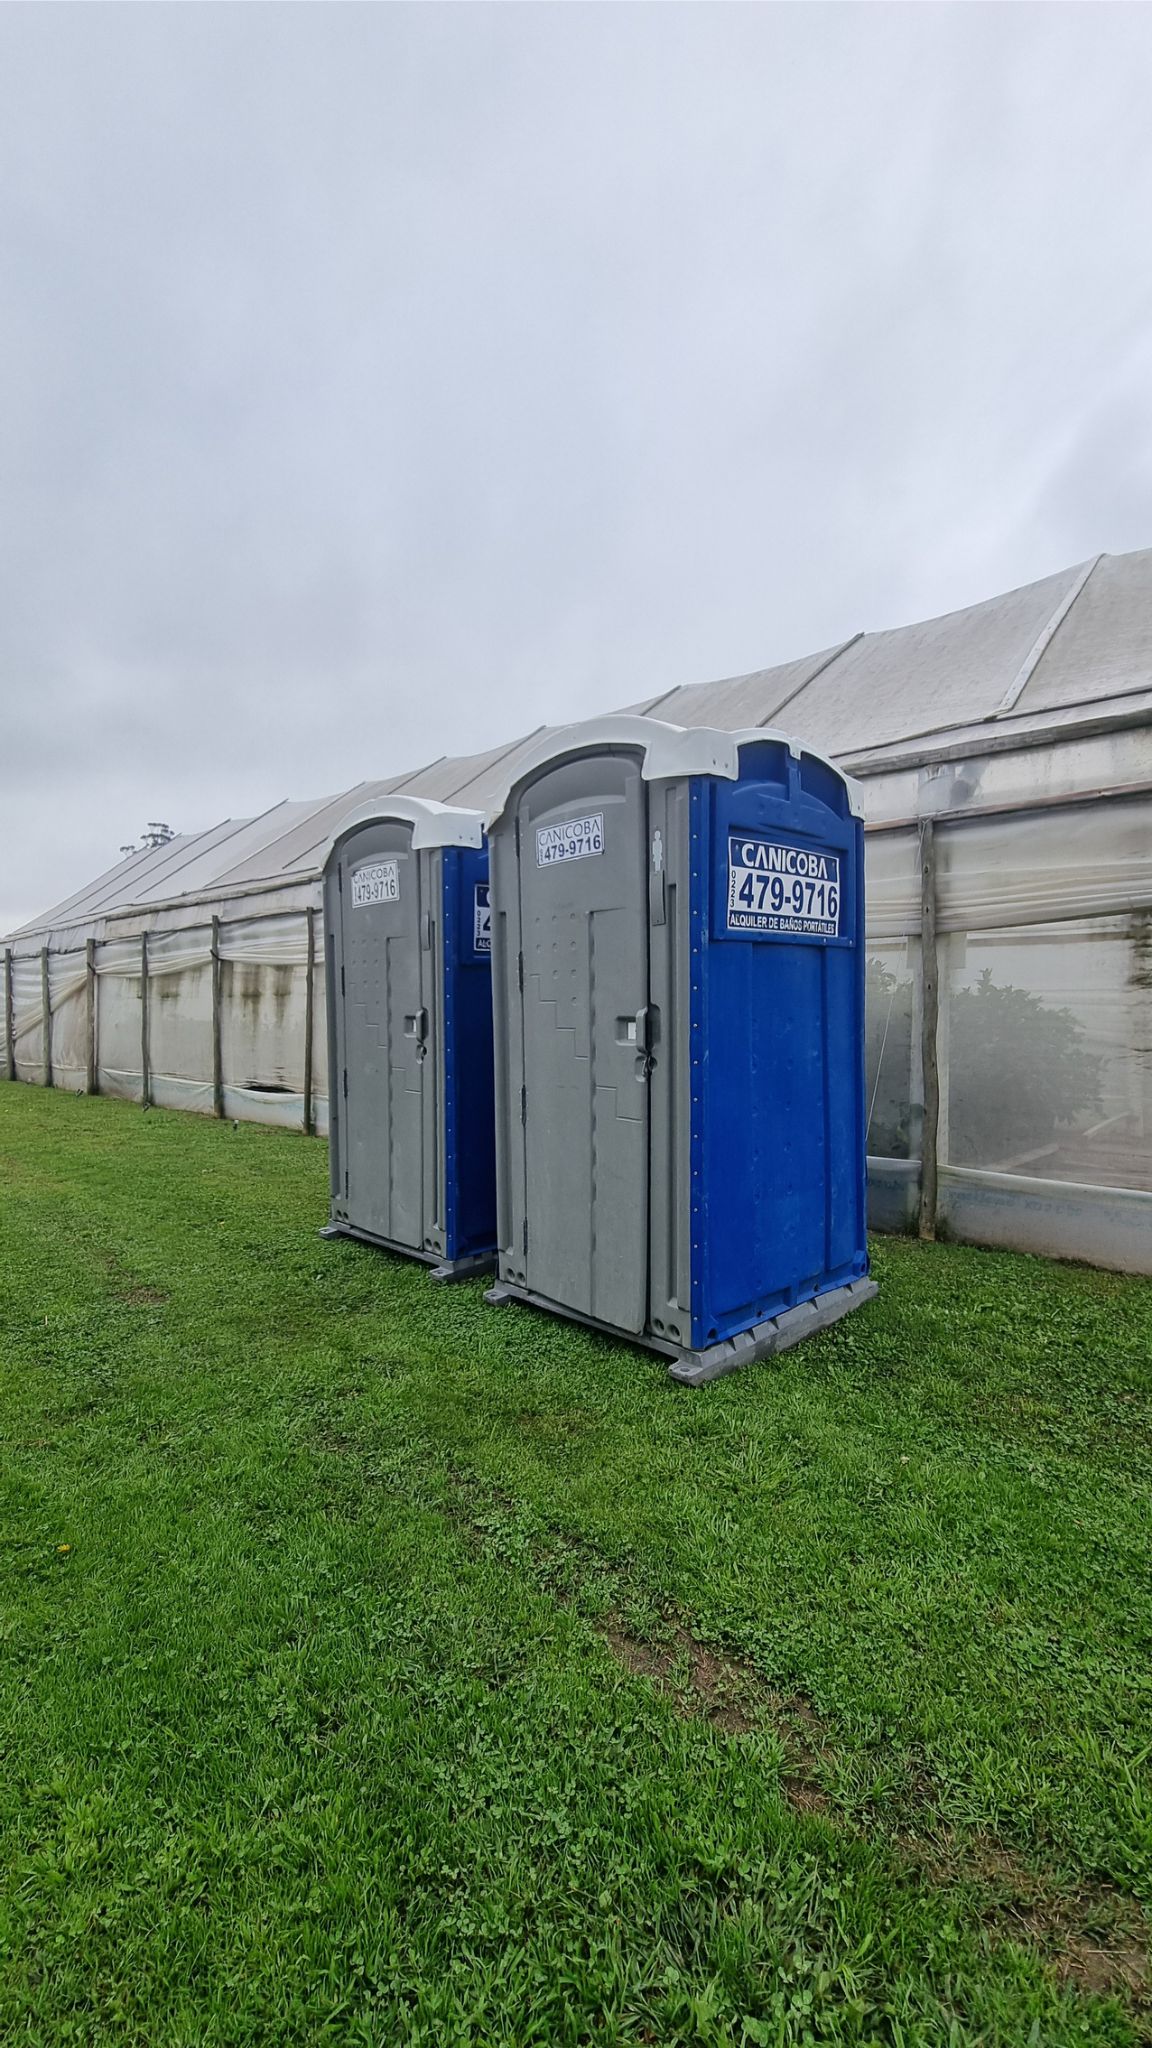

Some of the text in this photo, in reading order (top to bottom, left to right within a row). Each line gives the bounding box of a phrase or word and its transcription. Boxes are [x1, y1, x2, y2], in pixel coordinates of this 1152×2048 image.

[539, 819, 601, 846] CANICOBA
[544, 834, 601, 861] 479-9716
[741, 843, 828, 879] CANICOBA
[738, 872, 838, 918] 479-9716
[730, 913, 767, 928] ALQUILER
[768, 917, 779, 929] DE
[780, 917, 803, 931] BAÑOS
